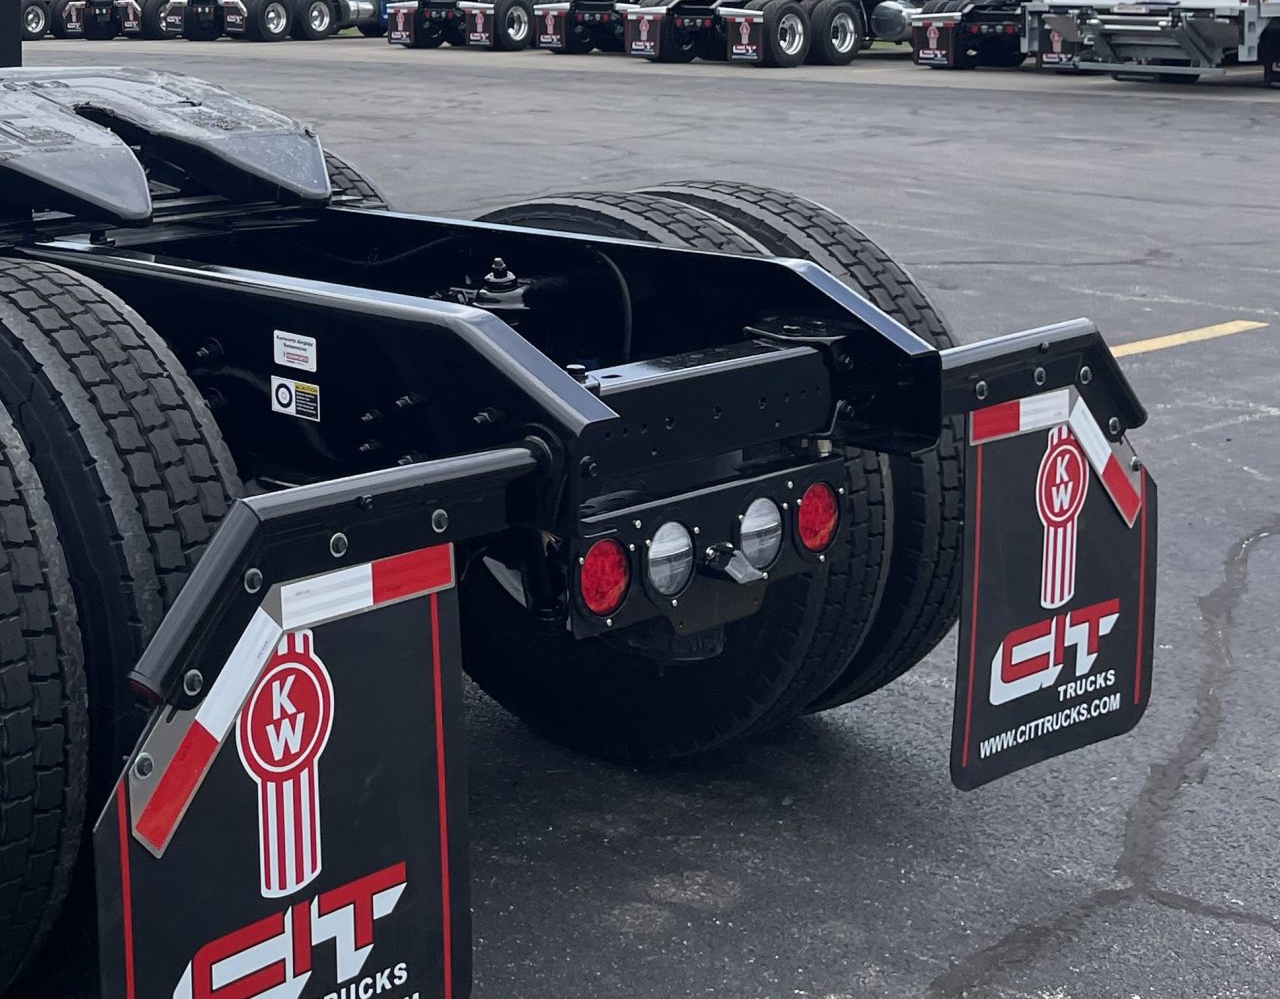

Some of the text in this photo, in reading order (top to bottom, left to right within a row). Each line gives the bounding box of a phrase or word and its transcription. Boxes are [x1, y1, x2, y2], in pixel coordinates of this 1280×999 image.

[989, 598, 1120, 706] CIT
[1057, 669, 1116, 702] TRUCKS
[979, 692, 1121, 759] WWW.CITTRUCKS.COM
[172, 861, 408, 999] CIT
